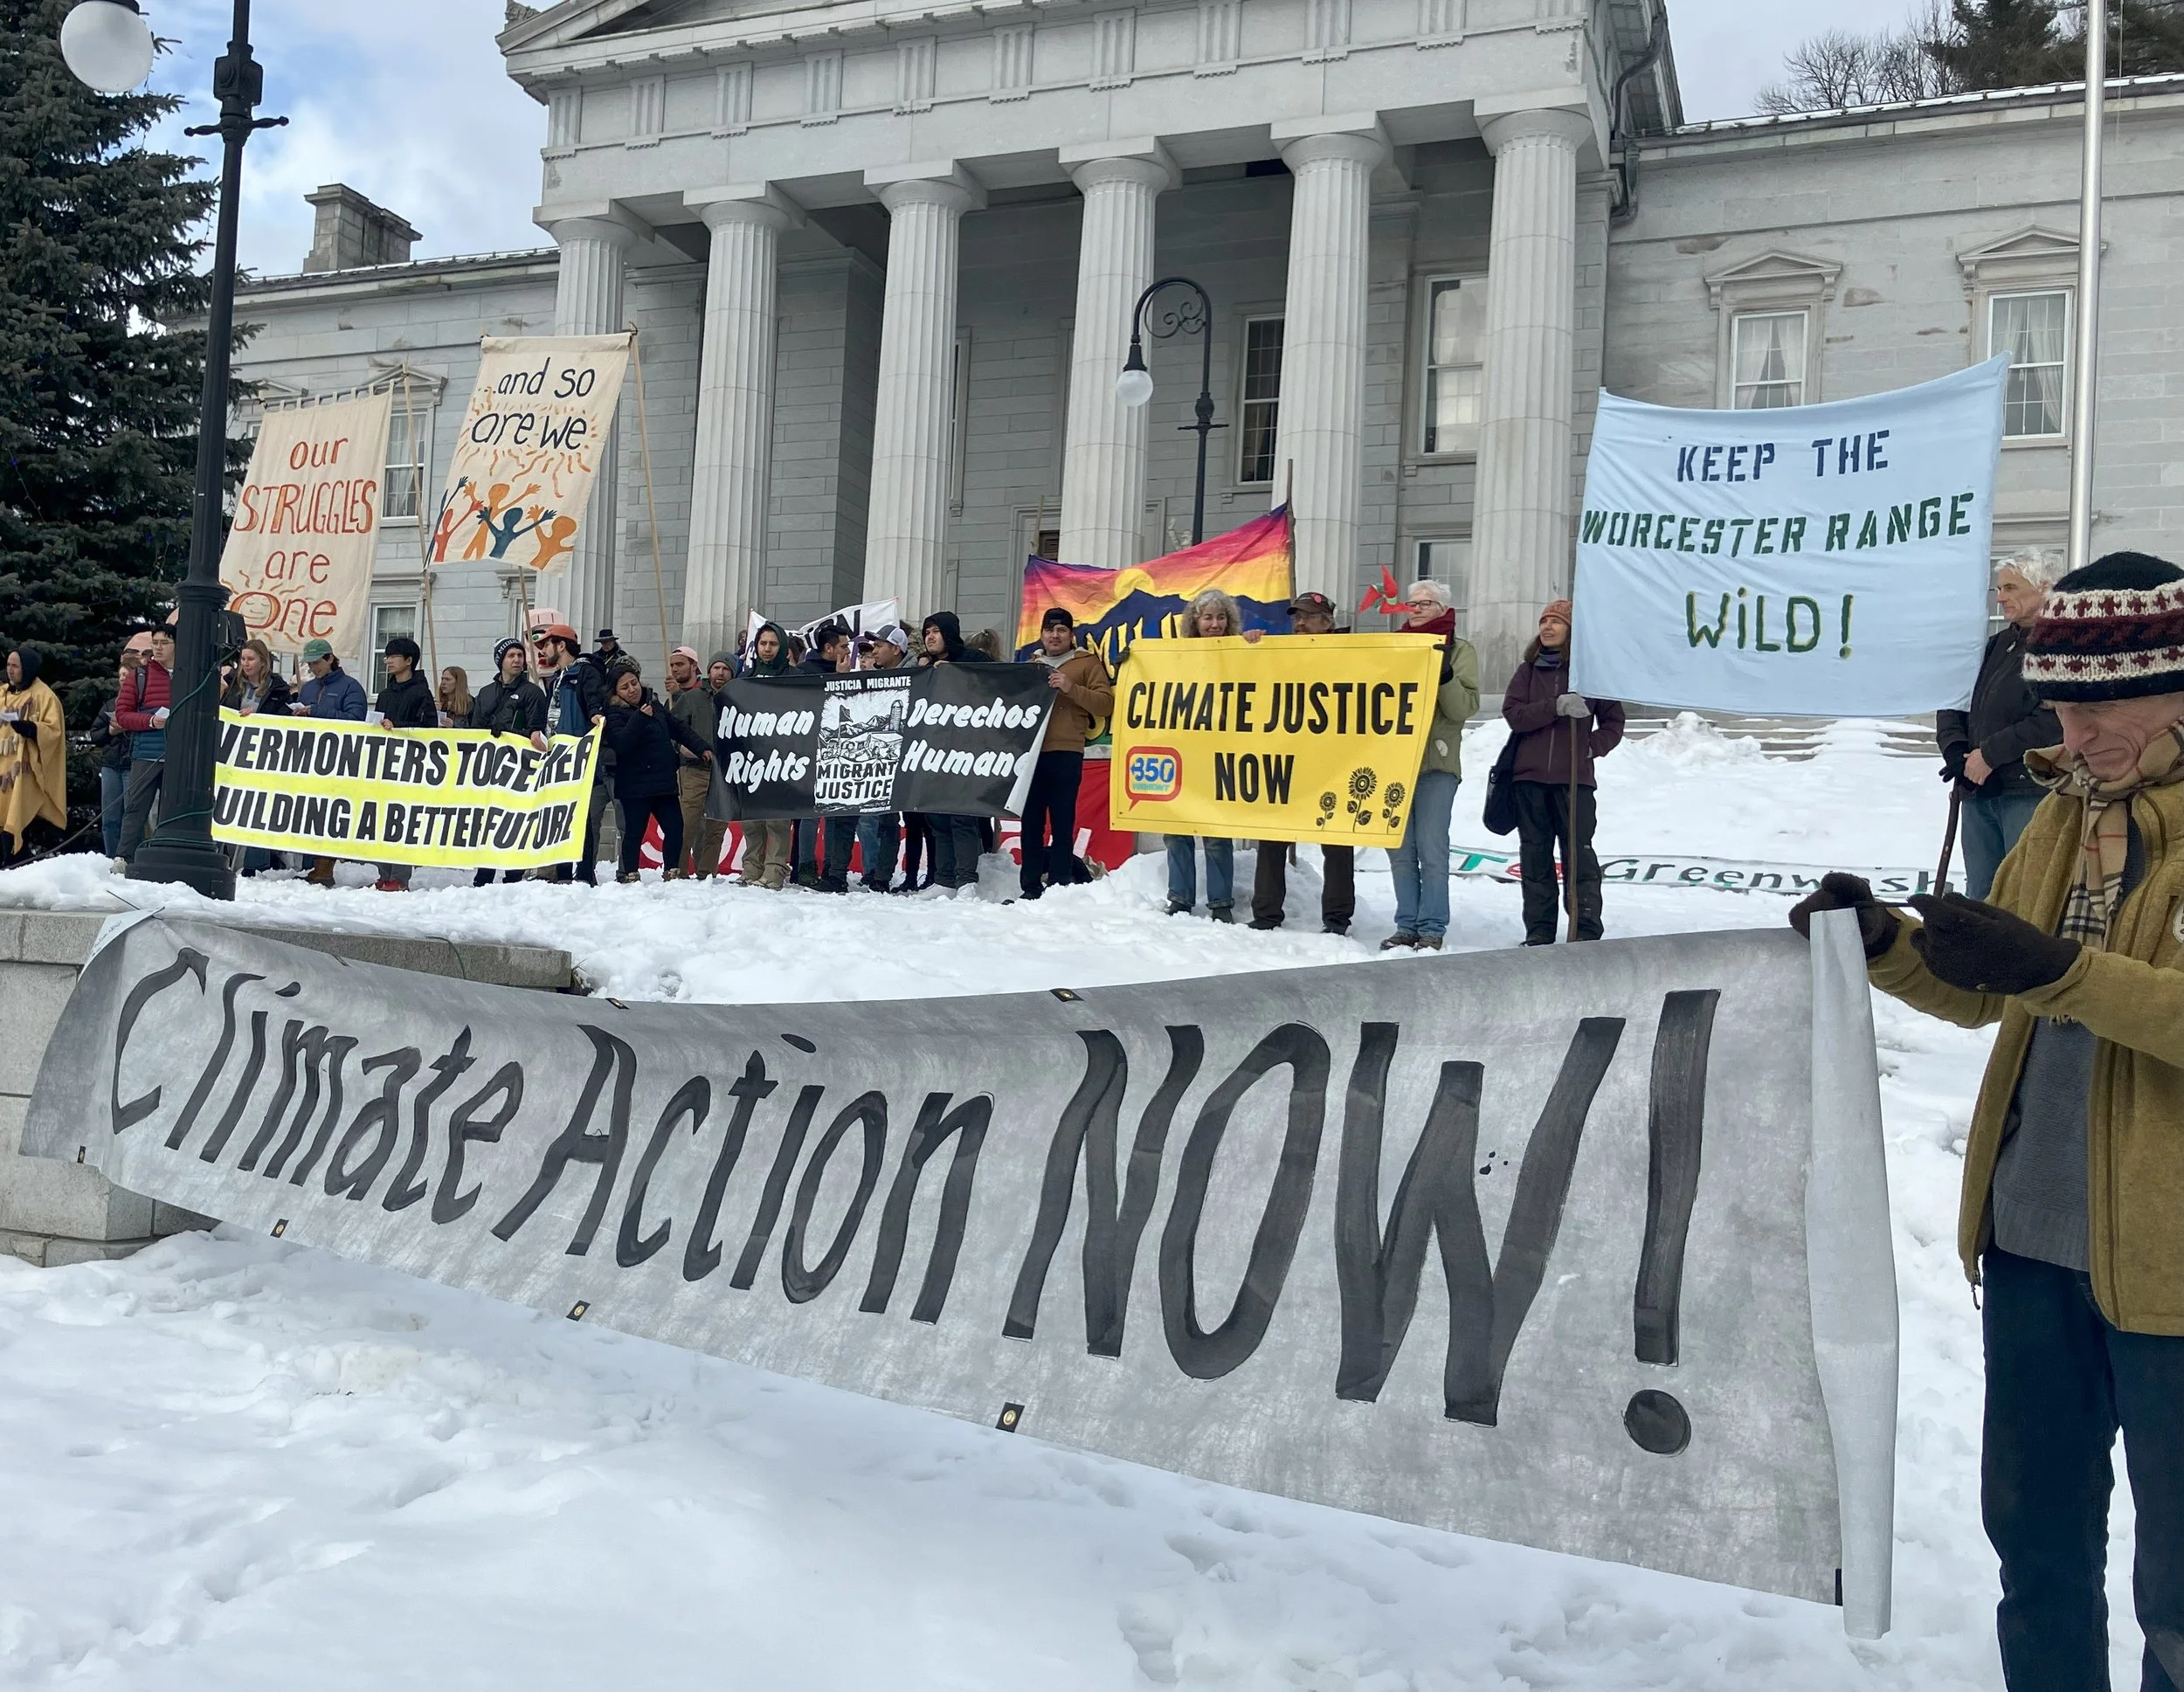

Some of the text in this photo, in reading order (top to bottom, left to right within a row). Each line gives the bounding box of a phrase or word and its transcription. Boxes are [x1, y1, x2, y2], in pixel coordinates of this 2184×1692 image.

[554, 368, 596, 398] so
[471, 412, 587, 451] are we
[289, 438, 349, 471] our
[1676, 429, 1890, 482] KEEP THE
[233, 479, 377, 535] STRUGGLES
[1581, 492, 1975, 558] WORCESTER RANGE
[265, 549, 331, 584] are
[230, 590, 338, 639] One
[824, 675, 911, 692] JUSTICIA MIGRANTE
[717, 705, 815, 740] Human
[907, 696, 1041, 729] Derechos
[1127, 681, 1257, 733] CLIMATE
[1262, 681, 1419, 736] JUSTICE
[215, 720, 450, 786] VERMONTERS
[724, 750, 811, 794] Rights
[817, 761, 897, 779] MIGRANT
[1130, 756, 1174, 783] 350
[816, 778, 893, 799] JUSTICE
[1214, 751, 1294, 805] NOW
[212, 785, 351, 839] UILDING
[356, 801, 377, 840] A
[113, 946, 1721, 1457] Climate Action NOW!
